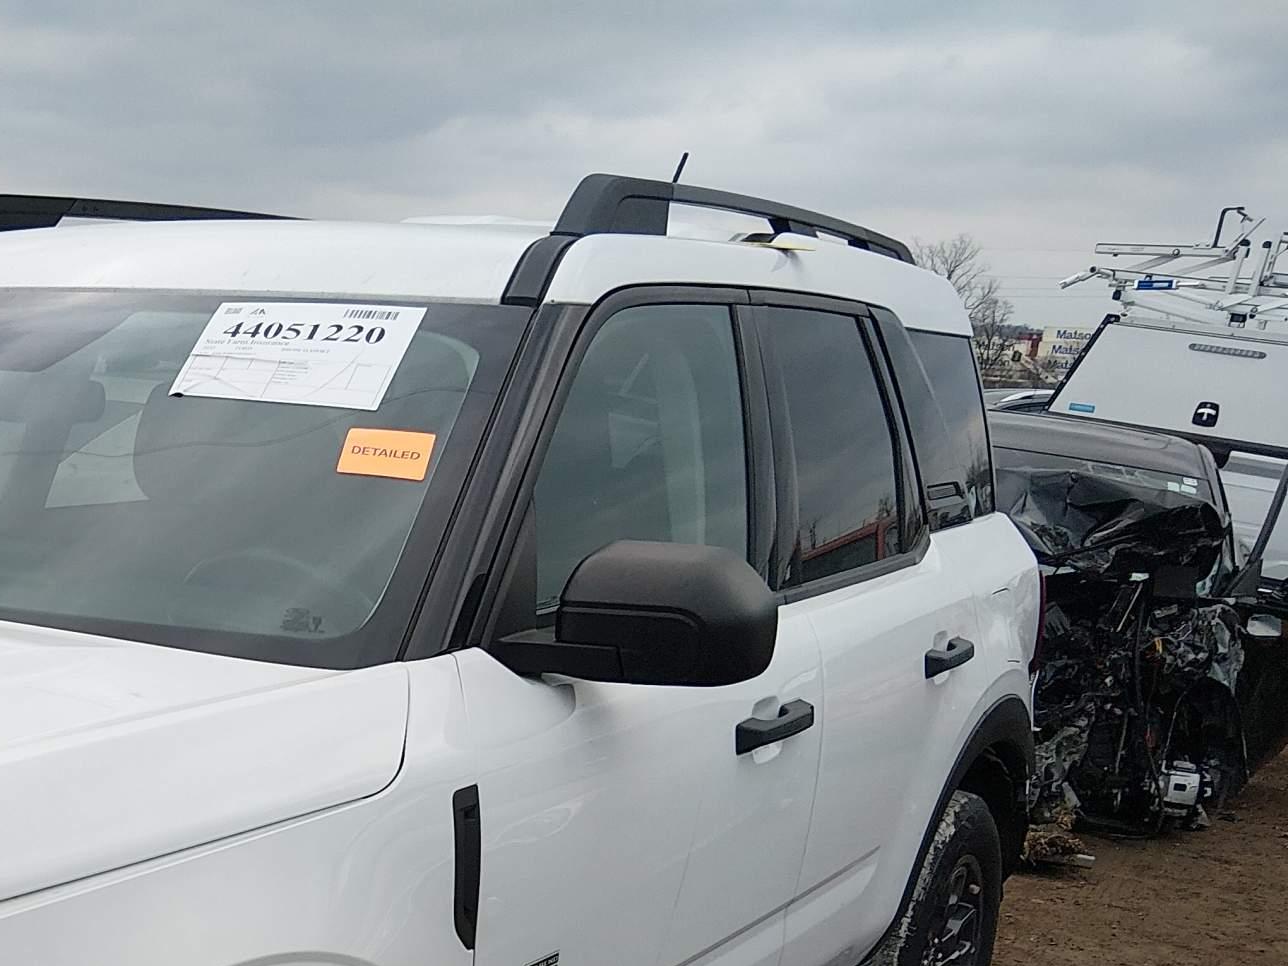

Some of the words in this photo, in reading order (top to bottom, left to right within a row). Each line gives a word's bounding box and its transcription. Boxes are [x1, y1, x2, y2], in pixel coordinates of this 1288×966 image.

[223, 321, 386, 344] 44051220
[1056, 329, 1093, 340] Matso
[1051, 344, 1081, 355] Mats
[350, 444, 421, 461] DETAILED
